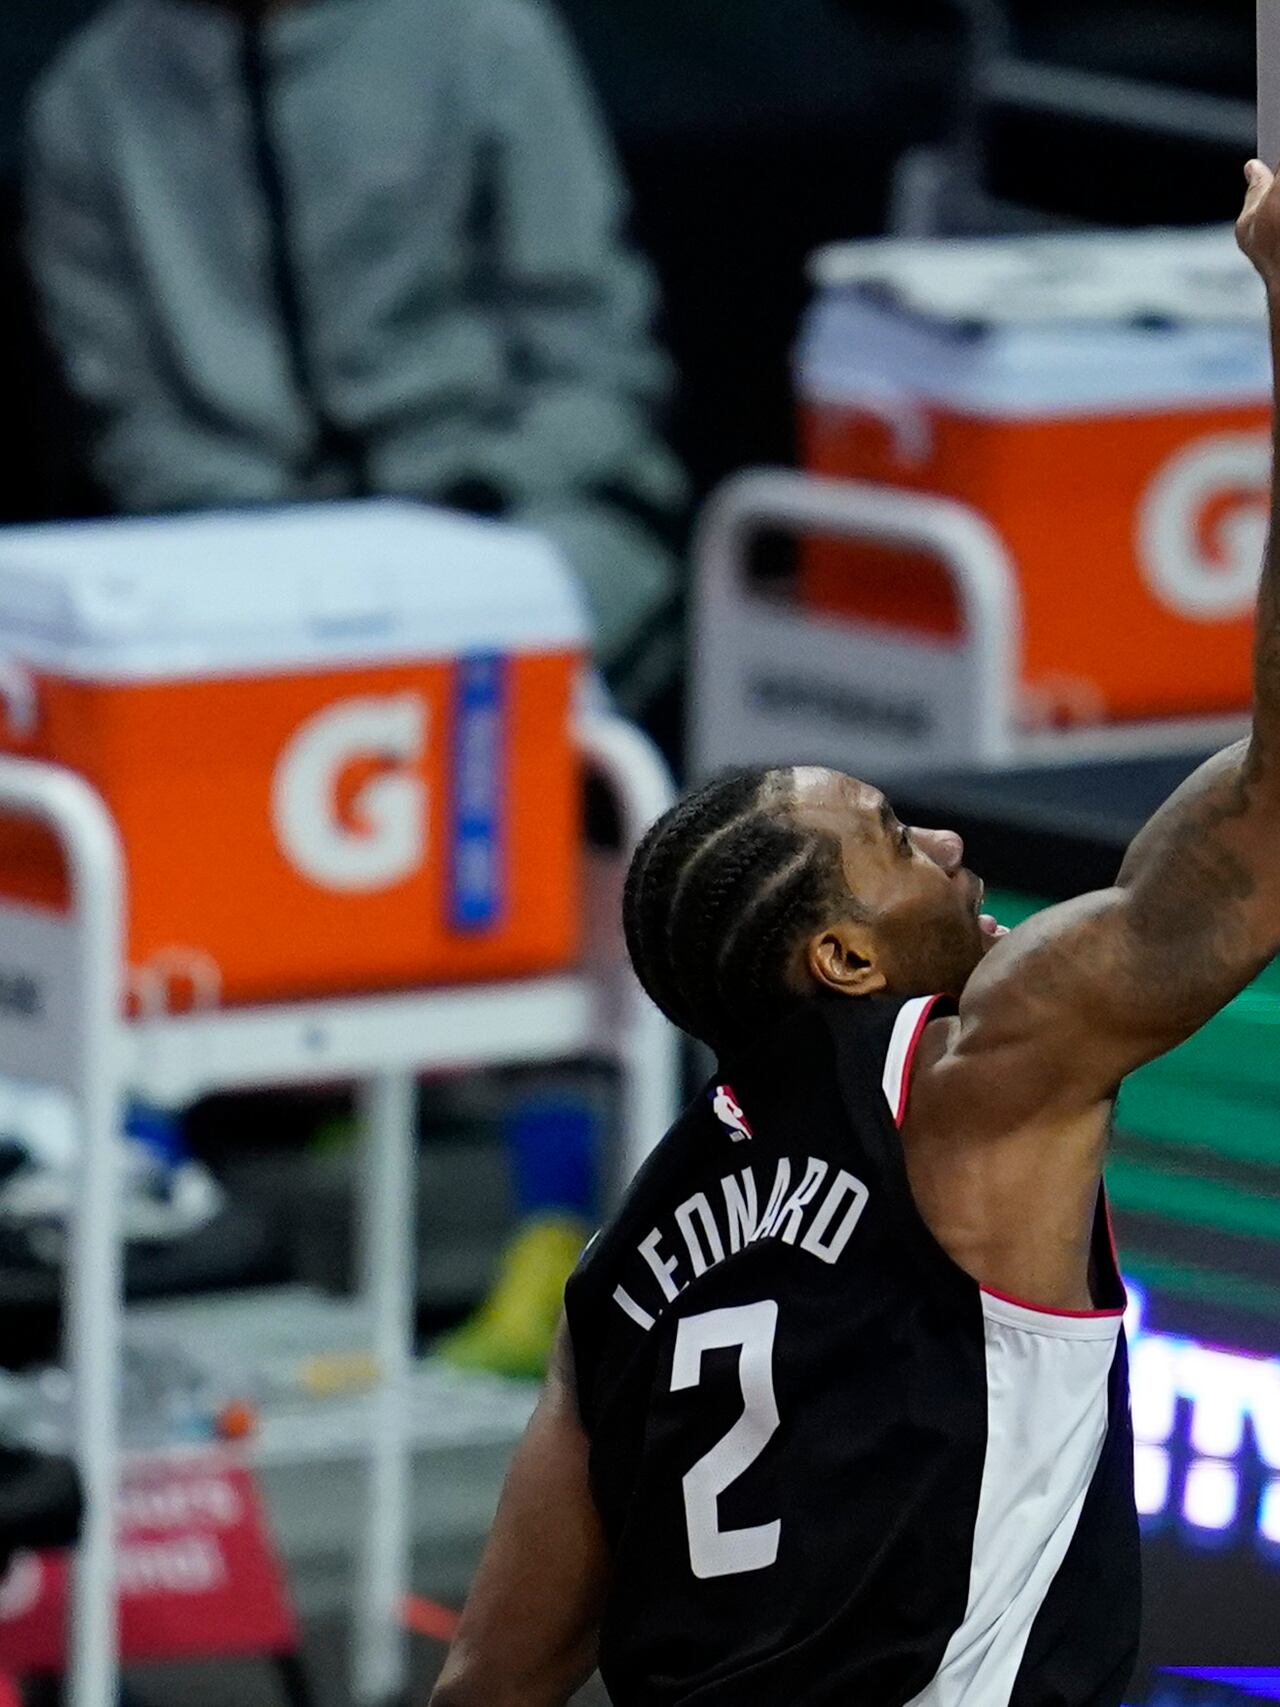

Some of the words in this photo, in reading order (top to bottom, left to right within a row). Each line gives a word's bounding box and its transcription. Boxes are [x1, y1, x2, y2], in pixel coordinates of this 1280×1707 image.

[270, 690, 429, 893] G
[612, 1156, 869, 1332] LEONARD
[670, 1299, 782, 1579] 2
